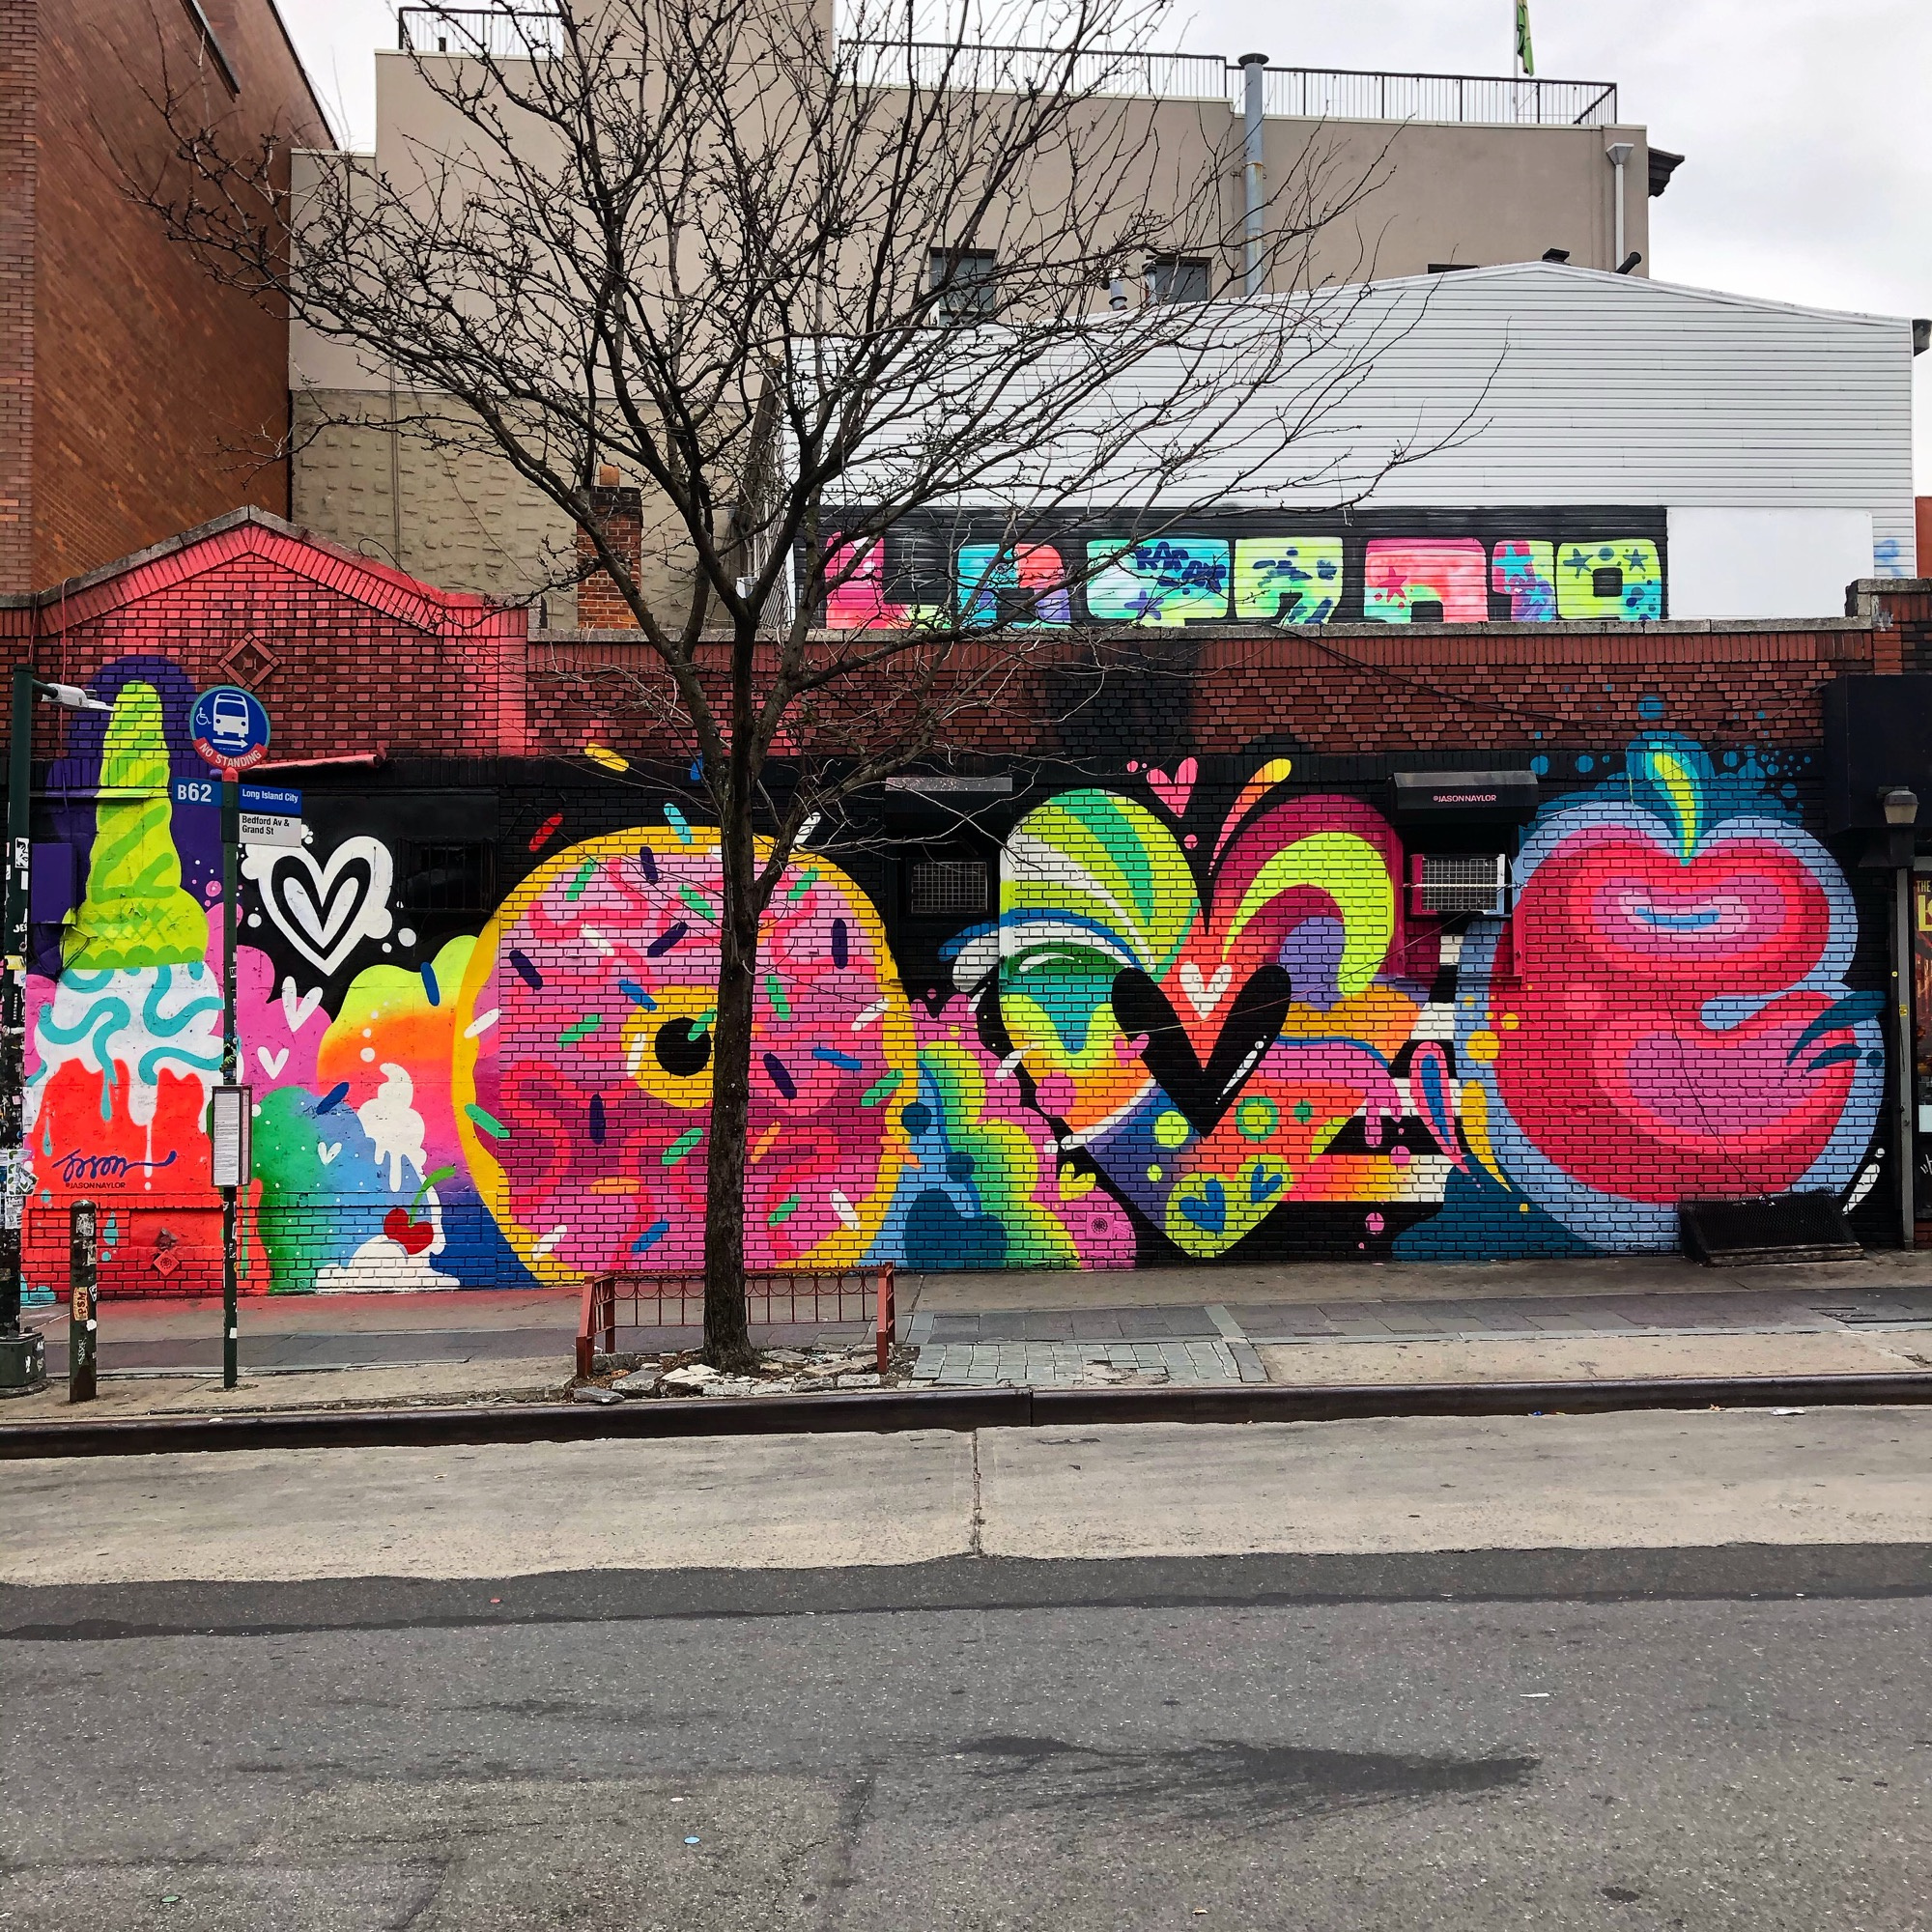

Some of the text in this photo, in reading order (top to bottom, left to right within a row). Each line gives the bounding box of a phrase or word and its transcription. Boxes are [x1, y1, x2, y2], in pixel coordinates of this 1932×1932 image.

[199, 742, 262, 768] NO STANDING
[177, 782, 213, 803] B62
[242, 788, 298, 804] Long Island City
[242, 815, 271, 825] Bedford
[284, 818, 290, 827] &
[266, 827, 274, 836] St
[1916, 880, 1931, 893] THE
